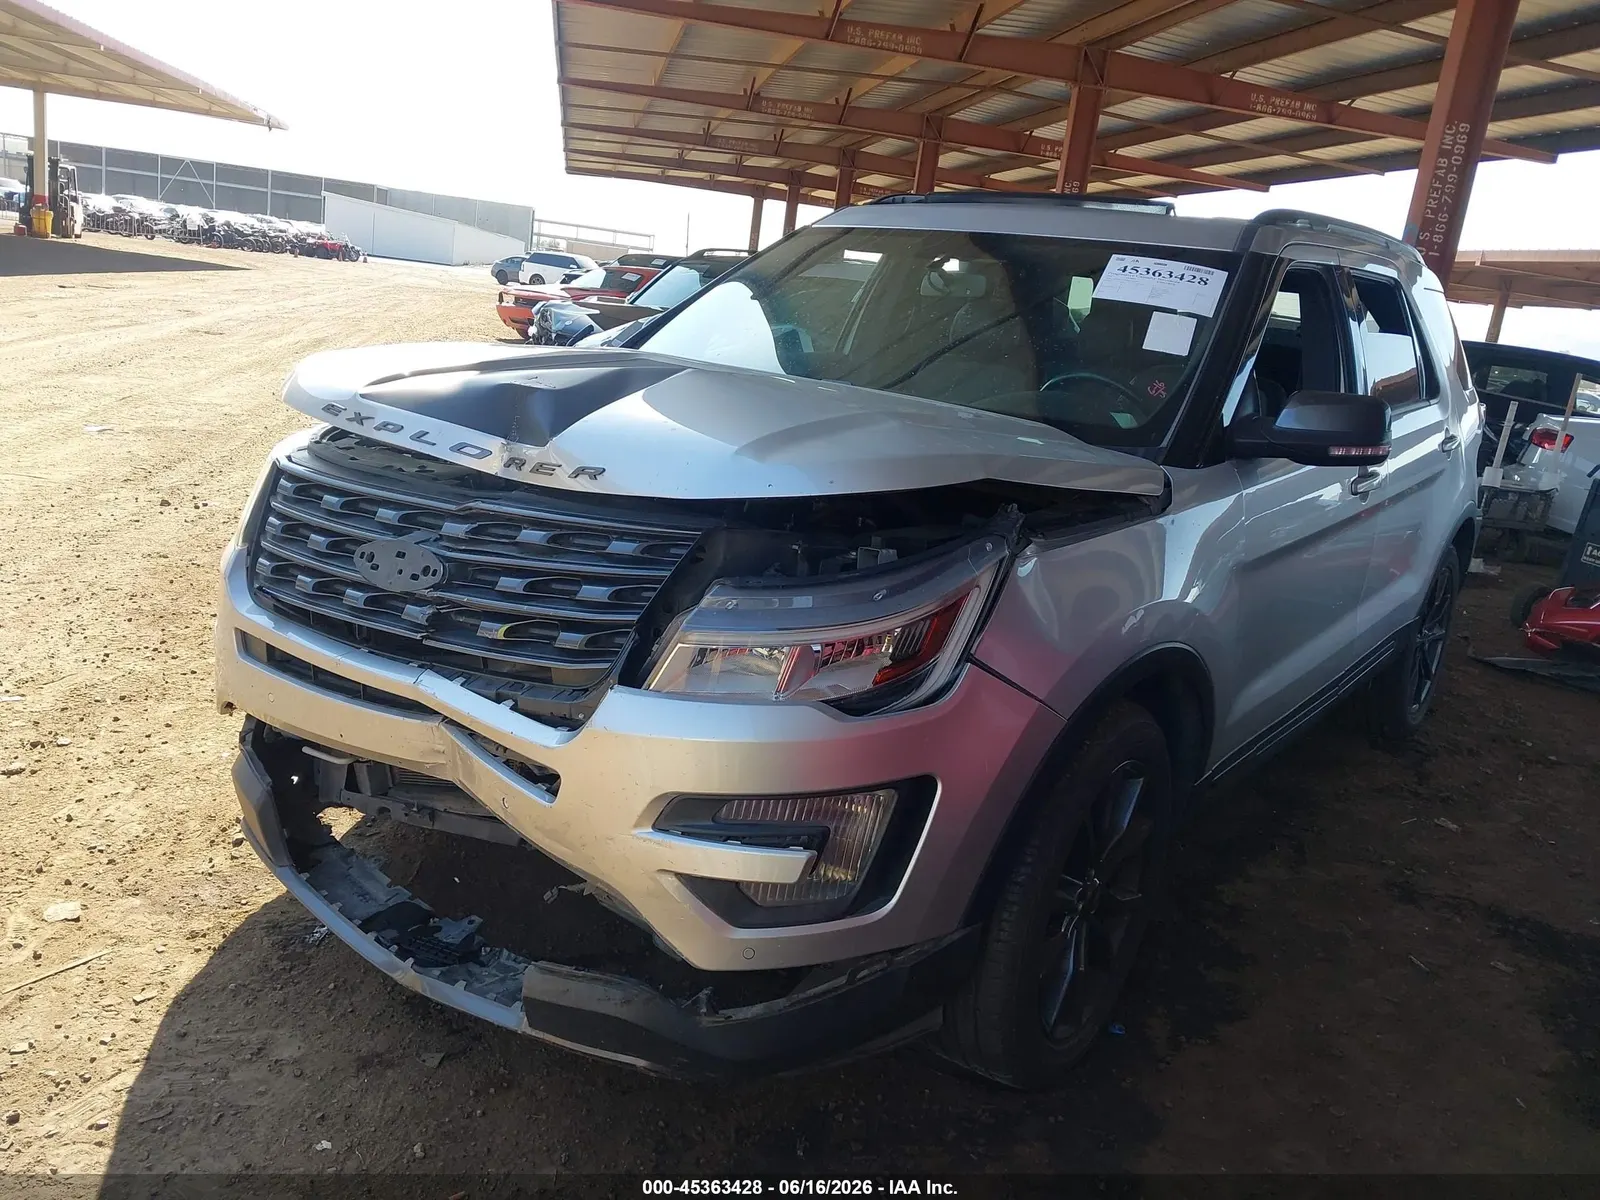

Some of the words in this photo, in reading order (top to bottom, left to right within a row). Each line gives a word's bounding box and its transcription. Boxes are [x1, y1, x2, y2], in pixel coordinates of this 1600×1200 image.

[1250, 93, 1266, 104] U.S.
[1270, 96, 1301, 109] PREFAB
[1424, 157, 1448, 218] PREFAB
[1441, 120, 1457, 149] INC.
[1428, 123, 1470, 256] 1-866-799-0969
[1117, 265, 1210, 286] 45363428
[321, 403, 606, 481] EXPLORER
